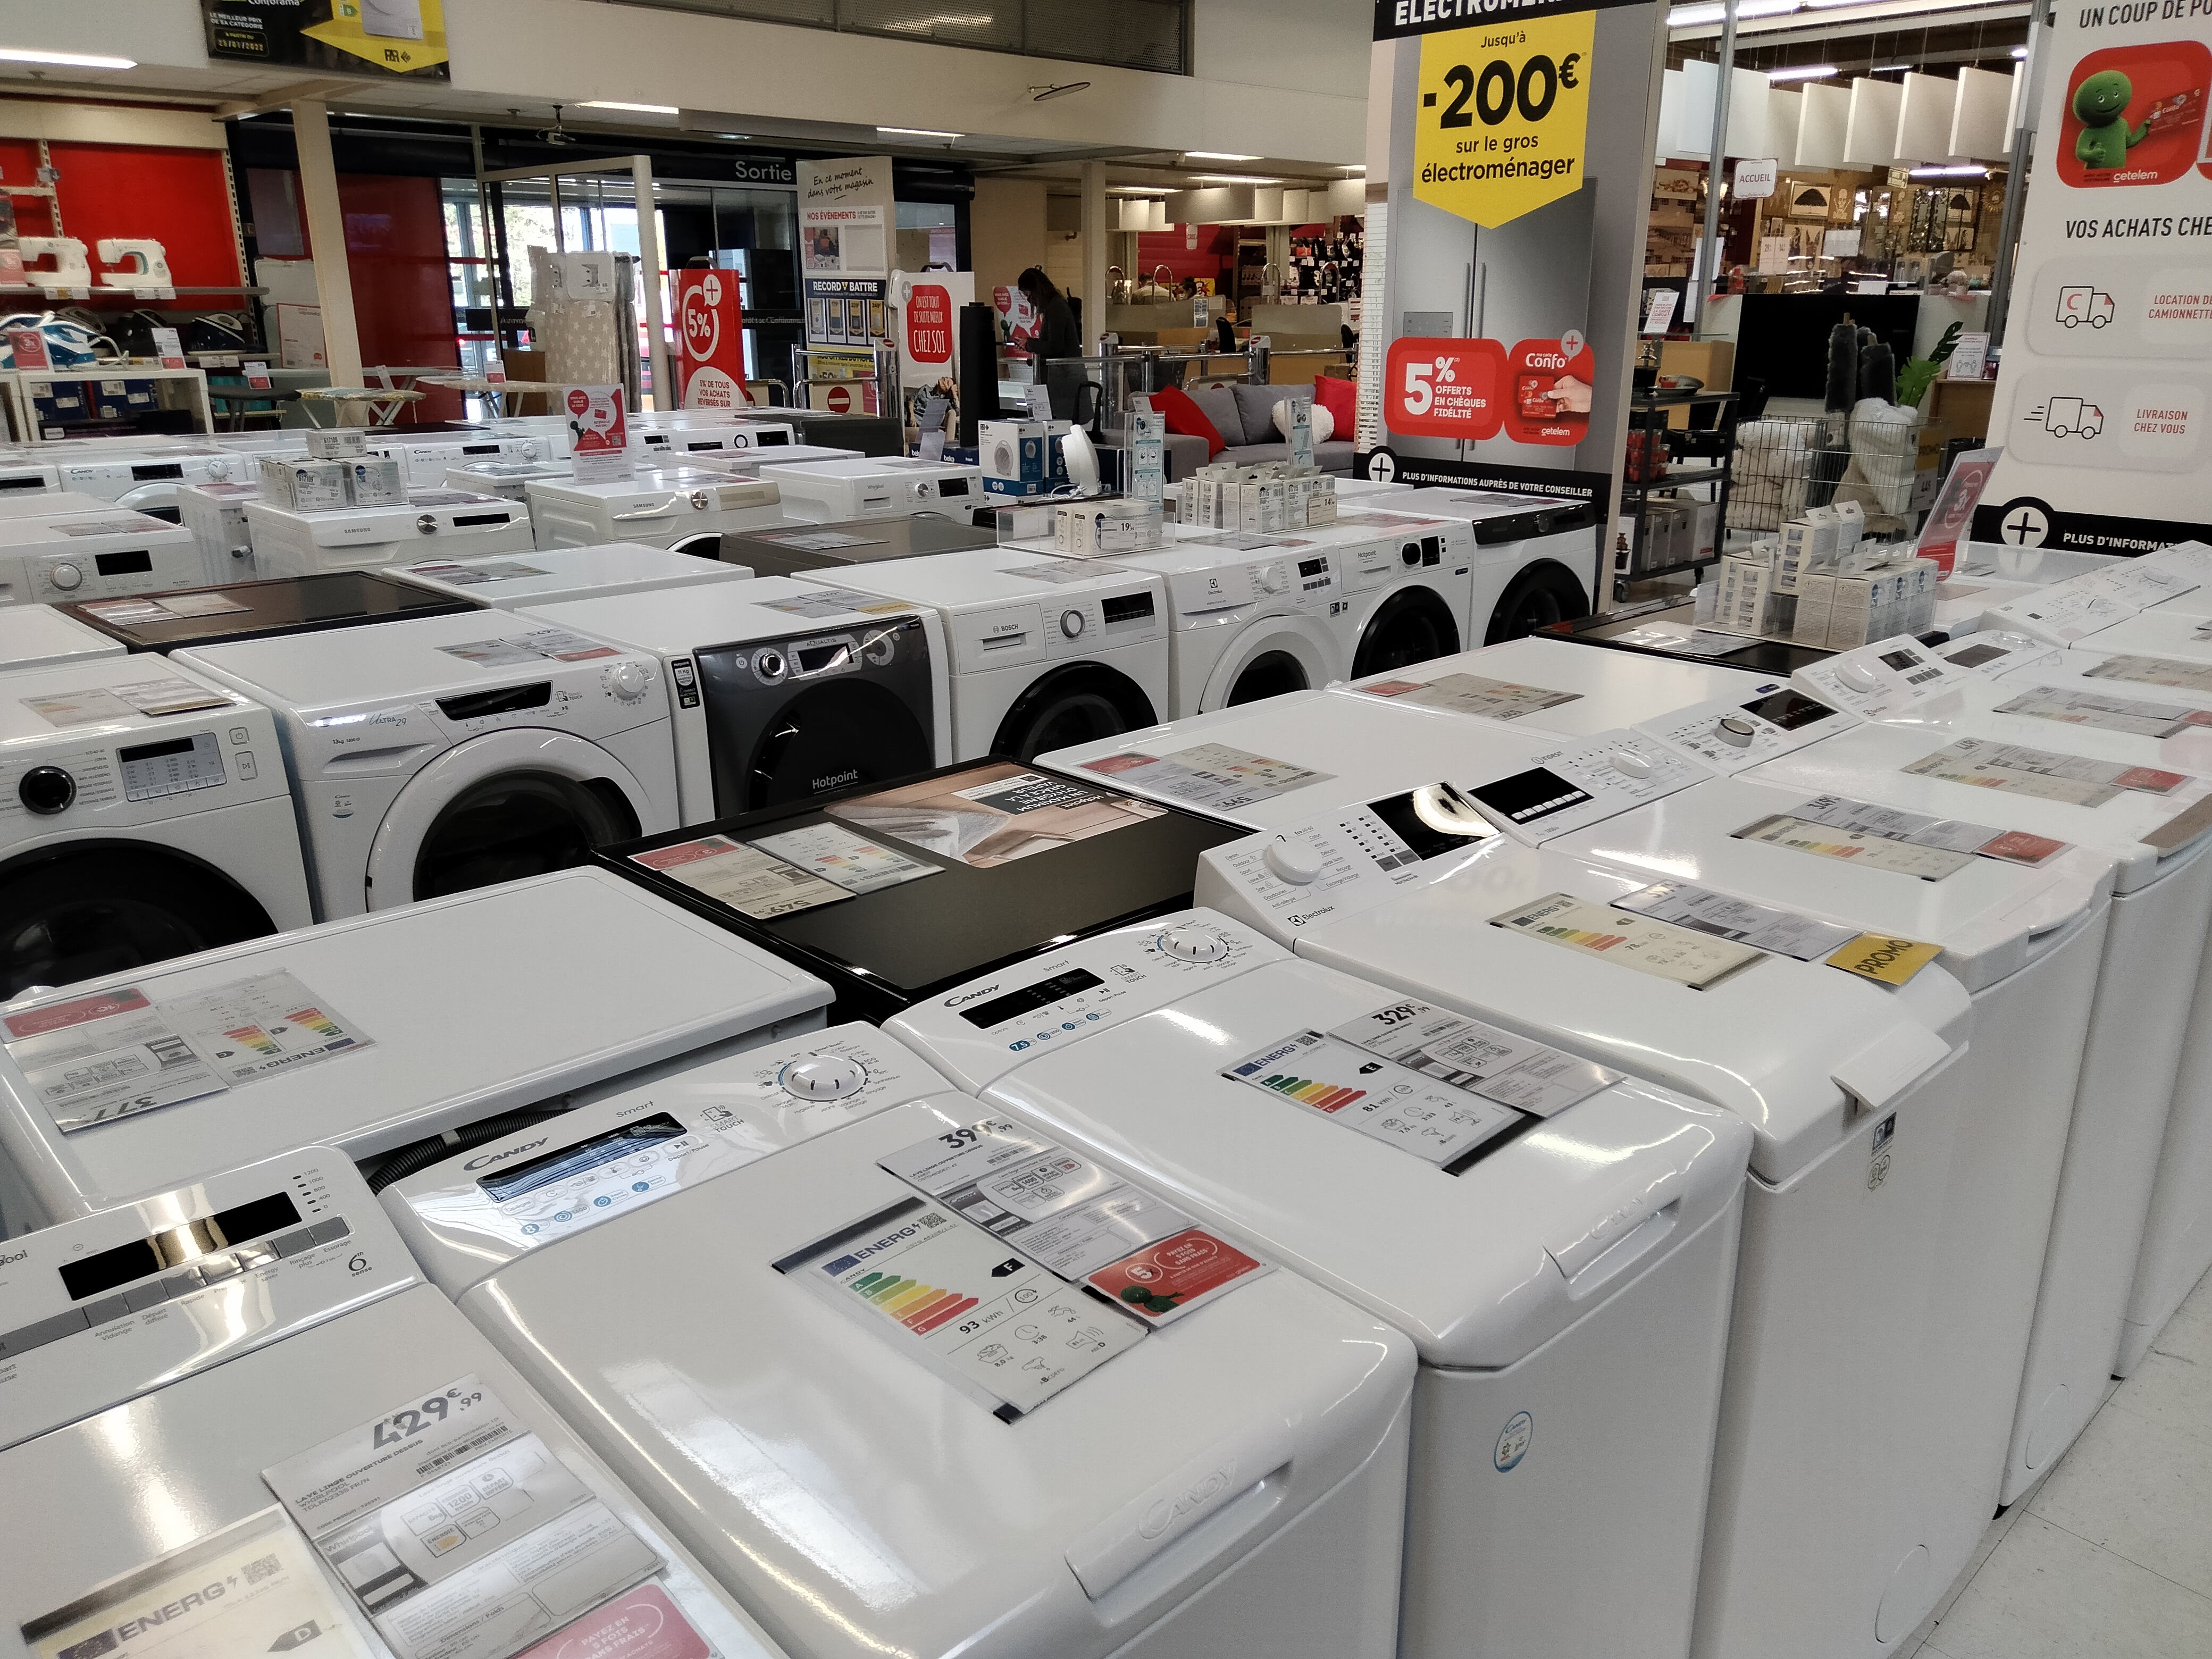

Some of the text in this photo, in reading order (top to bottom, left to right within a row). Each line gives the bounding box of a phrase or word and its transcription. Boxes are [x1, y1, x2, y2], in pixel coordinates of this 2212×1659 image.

[2079, 9, 2102, 29] UN
[2108, 4, 2158, 26] COUP
[2161, 0, 2184, 20] DE
[228, 21, 263, 29] CATÉGORIE
[1480, 32, 1527, 48] Jusqu'à
[1455, 135, 1538, 153] sur le gros
[735, 160, 792, 181] Sortie
[813, 176, 824, 186] En
[834, 166, 862, 181] moment
[1421, 157, 1575, 183] électroménager
[2113, 170, 2158, 183] cetelem
[1739, 173, 1771, 184] ACCUEIL
[808, 177, 874, 198] dans votre magasin
[807, 212, 819, 220] NOS
[820, 211, 857, 220] ÉVÈNEMENTS
[2066, 219, 2098, 239] VOS
[2101, 217, 2173, 238] ACHATS
[812, 281, 878, 292] RECORD BATTRE
[916, 296, 922, 308] ON
[929, 296, 940, 308] TOUT
[2154, 295, 2201, 306] LOCATION
[688, 309, 711, 338] 5%
[914, 311, 943, 323] DE SUITE MIEUX
[914, 330, 946, 354] CHEZ SOI
[1526, 353, 1566, 369] Confo
[715, 381, 730, 389] TOUS
[1435, 386, 1472, 396] OFFERTS
[709, 390, 730, 398] ACHATS
[697, 398, 719, 407] REVERSÉS
[1435, 395, 1486, 408] EN CHÈQUES
[1434, 406, 1472, 419] FIDÉLITÉ
[2136, 409, 2188, 422] LIVRAISON
[1541, 427, 1570, 437] cetelem
[2133, 422, 2185, 434] CHEZ VOUS
[1402, 472, 1593, 497] PLUS D'INFORMATIONS AUPRÈS DE VOTRE CONSEILLER
[2063, 533, 2094, 544] PLUS
[1358, 549, 1377, 558] Hotpoint
[806, 638, 837, 647] AQUALTIS
[395, 718, 407, 726] 29
[812, 769, 858, 790] Hotpoint
[1012, 781, 1058, 794] VAPEUR
[1016, 790, 1088, 812] UN MAXIMUM
[1060, 794, 1104, 809] Hotpoint
[1232, 859, 1250, 868] Outdoor
[1335, 864, 1352, 873] Rinçage
[1263, 889, 1287, 901] Doudounes
[1302, 905, 1335, 921] Electrolux
[1528, 904, 1559, 921] ENERG
[1853, 938, 1914, 975] PROMO
[1043, 959, 1070, 973] Smart
[1120, 971, 1142, 982] SMART
[1125, 974, 1147, 985] TOUCH
[943, 983, 1000, 1008] CANDY
[1256, 1045, 1295, 1067] ENERG
[616, 1100, 655, 1118] Smart
[1362, 1103, 1380, 1113] 81
[710, 1115, 738, 1130] SMART
[714, 1118, 745, 1133] TOUCH
[463, 1136, 549, 1171] CANDY
[937, 1144, 984, 1166] OUVERTURE DESSUS
[1590, 1193, 1646, 1241] CANDY
[323, 1239, 351, 1253] Essorage
[853, 1226, 916, 1260] ENERG
[289, 1253, 316, 1266] Rinçage
[298, 1260, 313, 1270] plus
[254, 1266, 279, 1279] Energy
[351, 1266, 373, 1277] sense
[1003, 1263, 1013, 1271] F
[840, 1268, 866, 1284] CANDY
[180, 1294, 205, 1306] Rapide
[1019, 1292, 1033, 1302] 100
[141, 1308, 167, 1320] Départ
[145, 1312, 169, 1326] différé
[94, 1319, 135, 1338] Annulation
[959, 1320, 981, 1334] 93
[102, 1327, 132, 1342] Vidange
[295, 1438, 424, 1504] LAVE LINGE OUVERTURE DESSUS
[447, 1491, 473, 1511] 1200
[1138, 1458, 1236, 1540] CANDY
[116, 1582, 225, 1642] ENERG
[440, 1619, 480, 1645] Dimensions
[485, 1605, 505, 1619] Poids
[293, 1626, 312, 1642] D
[581, 1623, 615, 1647] PAYEZ
